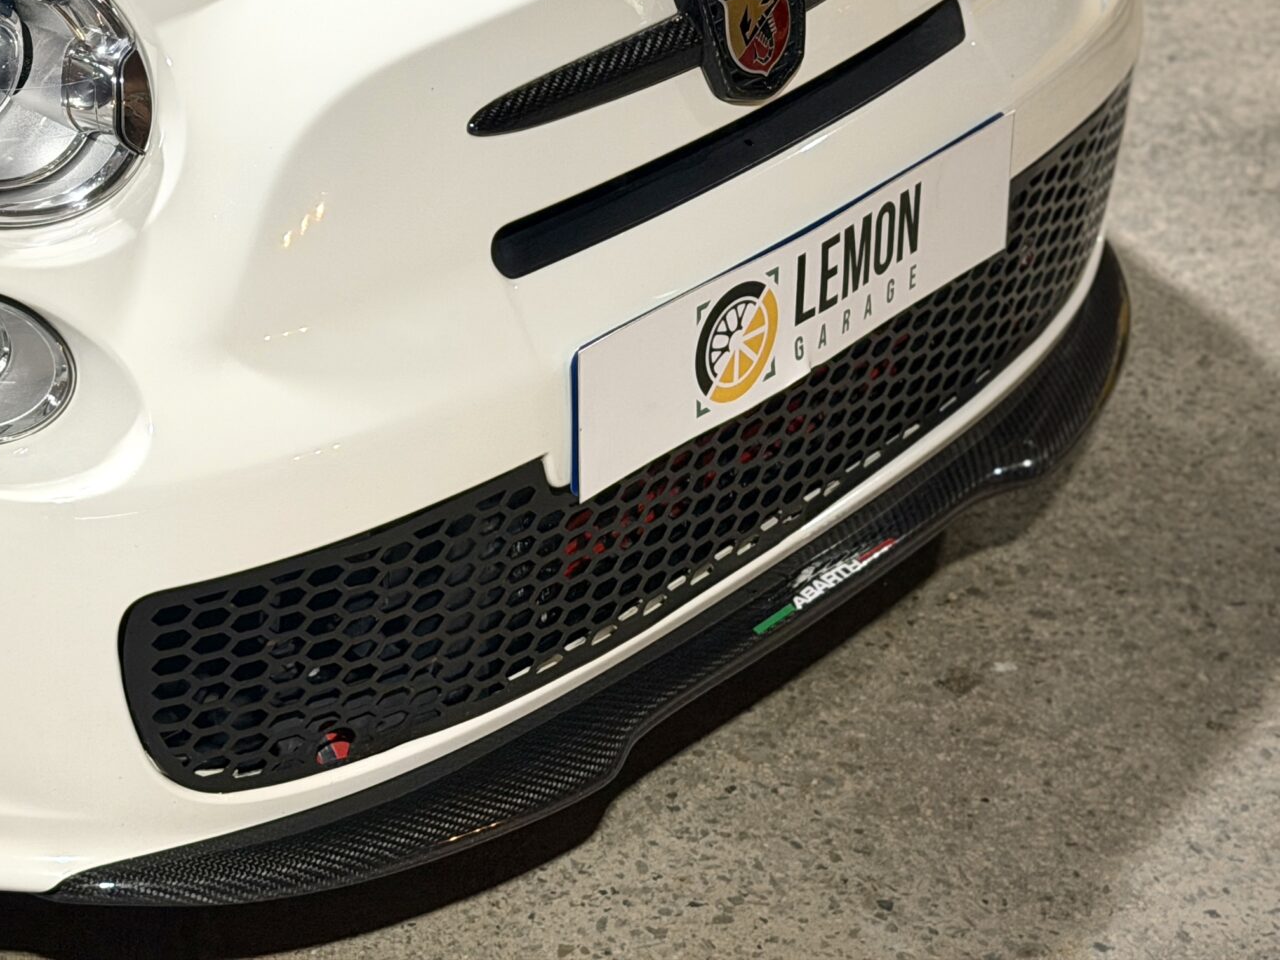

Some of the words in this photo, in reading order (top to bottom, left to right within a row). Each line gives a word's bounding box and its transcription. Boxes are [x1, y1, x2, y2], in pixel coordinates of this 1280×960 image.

[795, 181, 922, 327] LEMON
[795, 263, 918, 362] GARAGE
[793, 559, 862, 610] ABARTH
